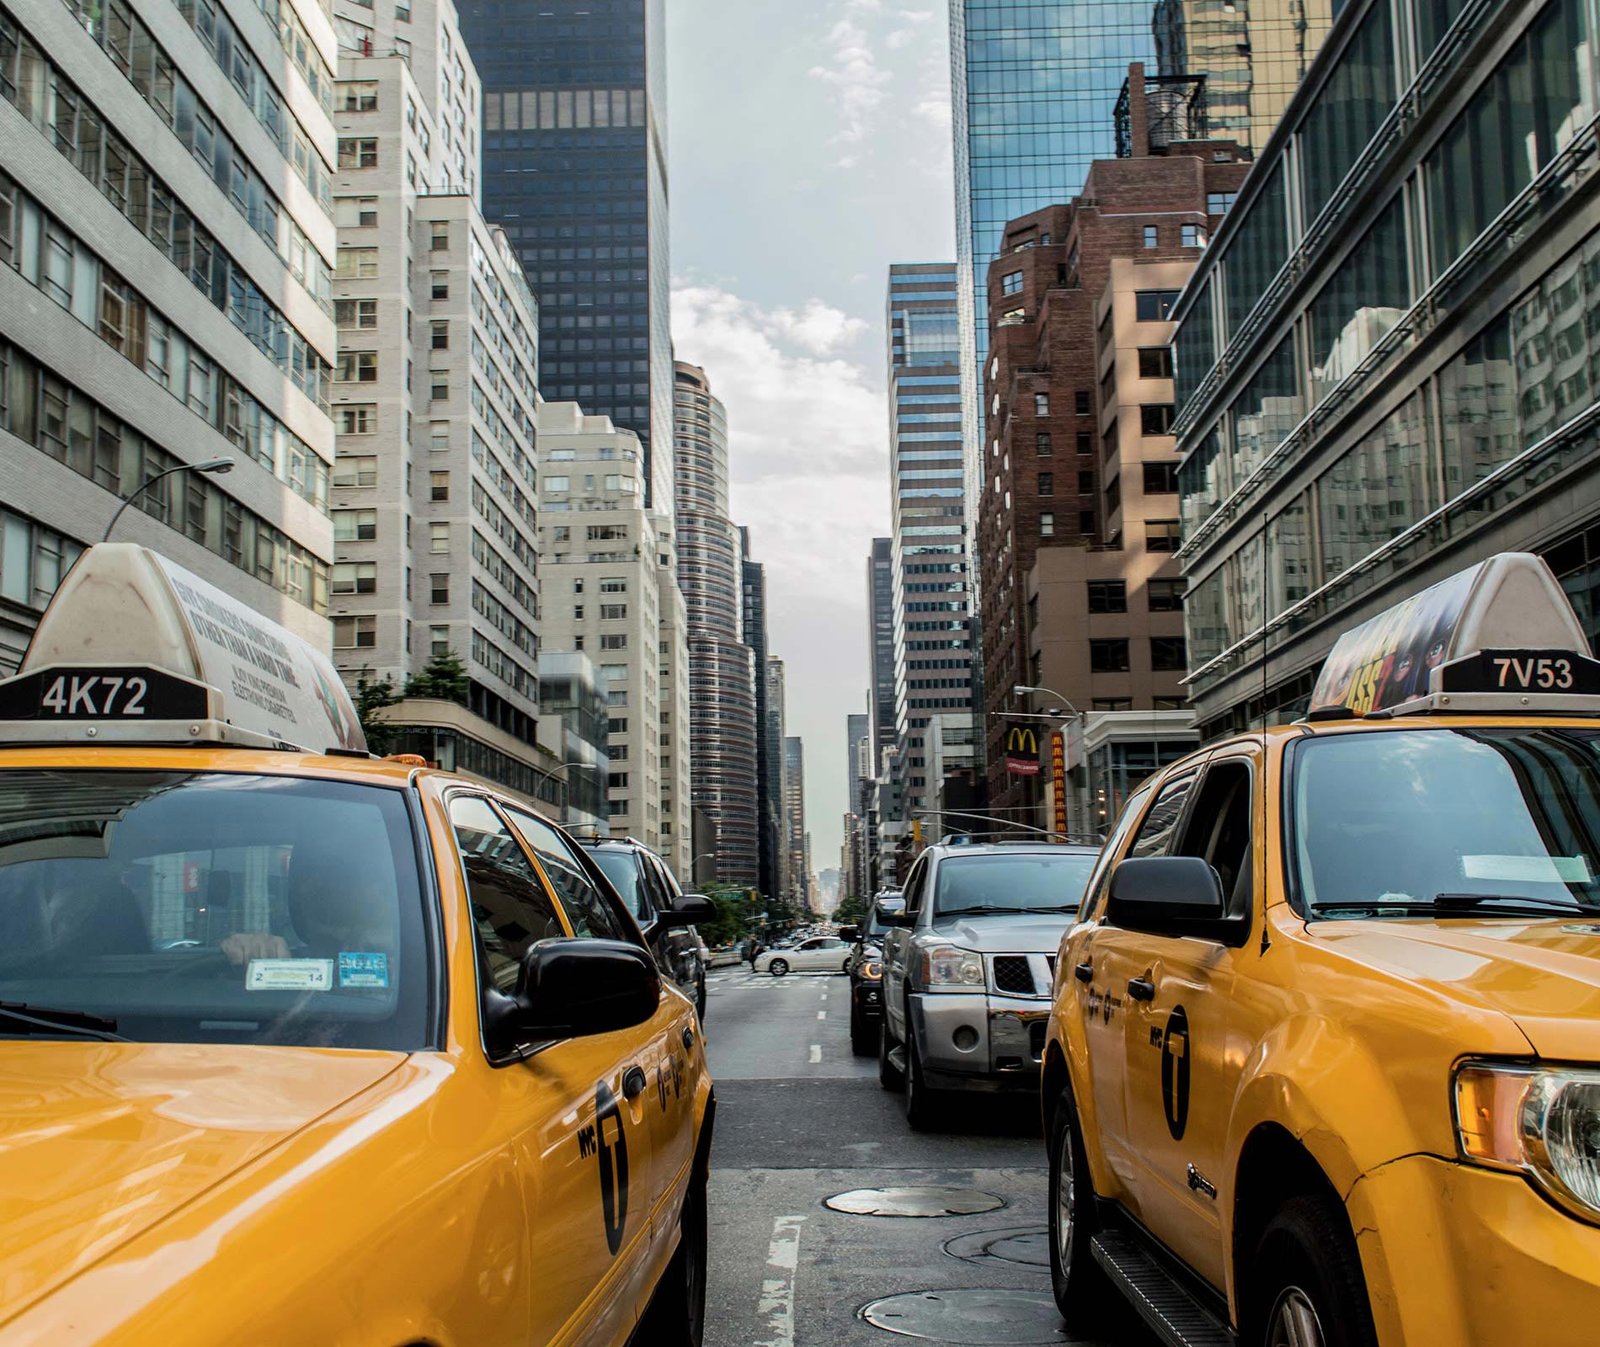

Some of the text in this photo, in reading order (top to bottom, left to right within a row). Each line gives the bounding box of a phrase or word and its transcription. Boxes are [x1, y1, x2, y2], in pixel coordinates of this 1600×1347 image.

[1494, 658, 1573, 689] 7V53
[43, 676, 147, 715] 4K72
[255, 973, 323, 982] 2 14
[577, 1125, 597, 1159] NYC
